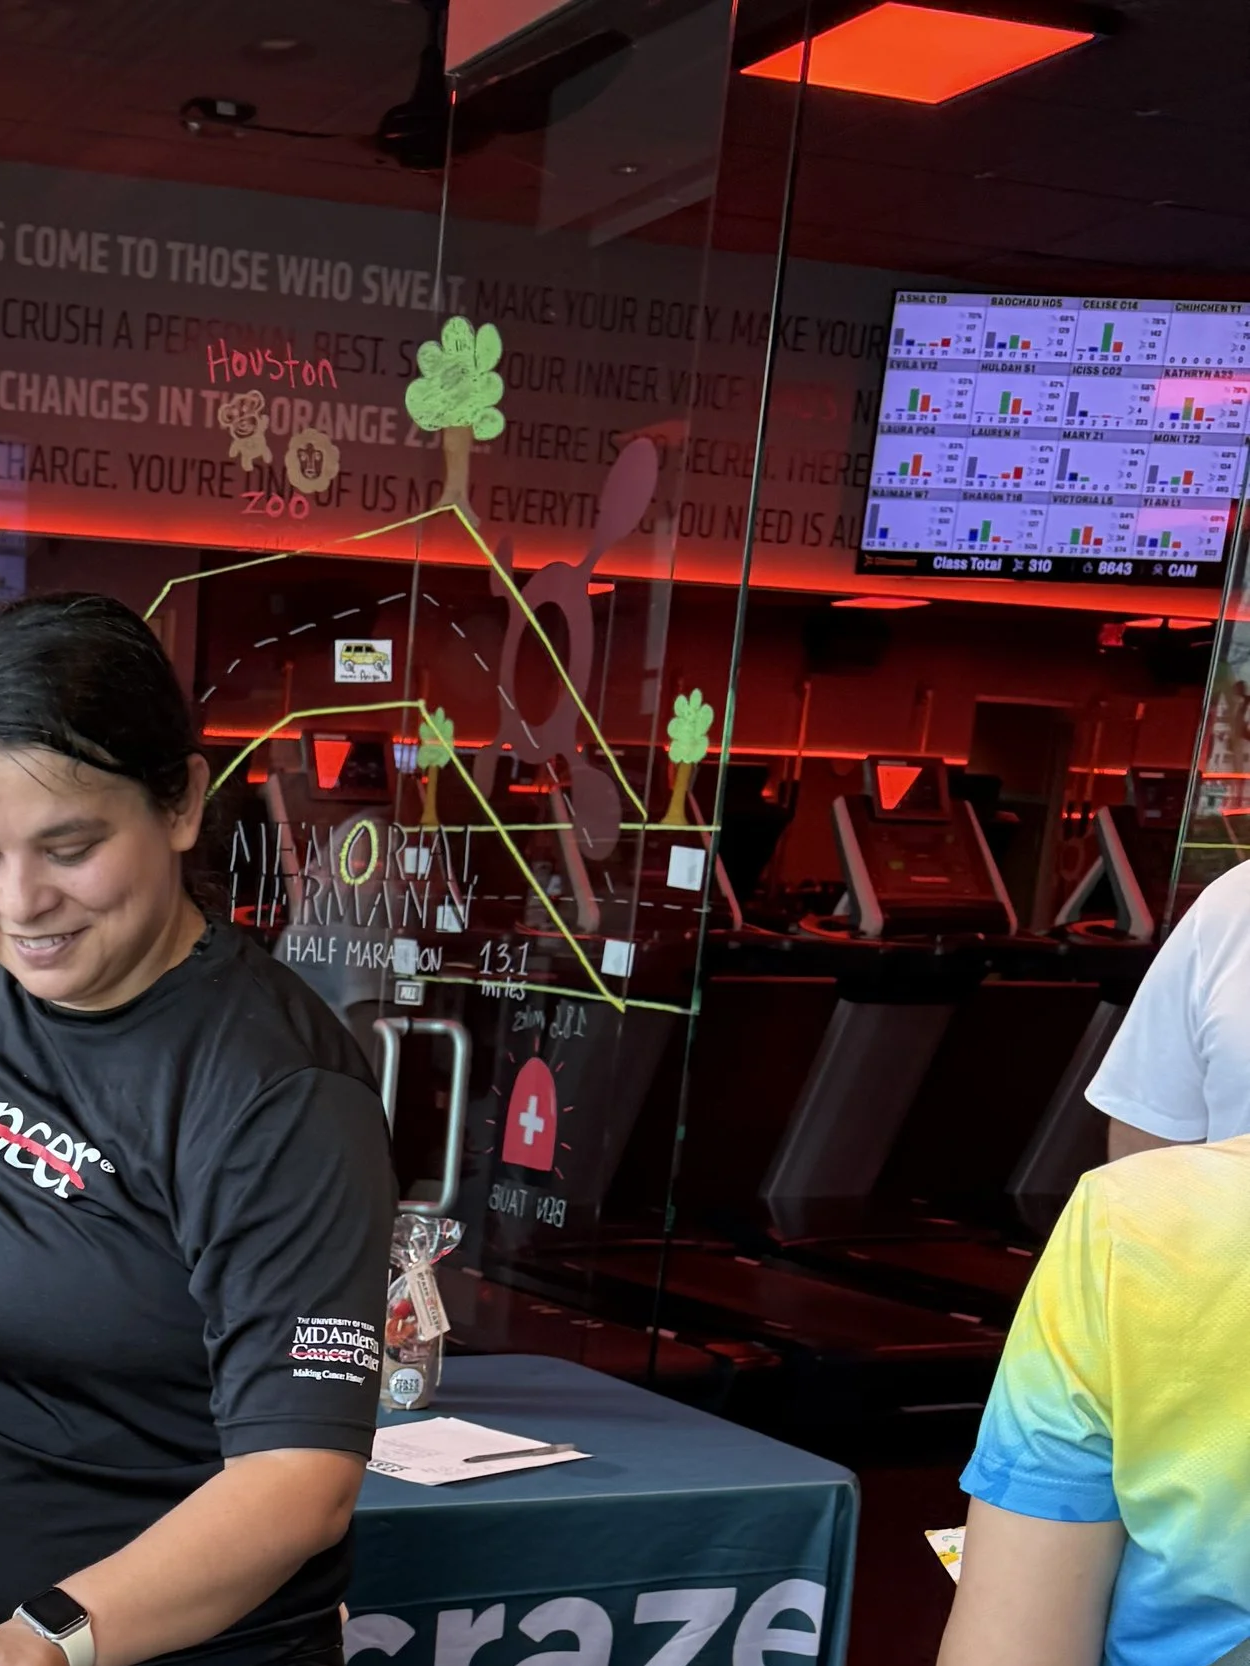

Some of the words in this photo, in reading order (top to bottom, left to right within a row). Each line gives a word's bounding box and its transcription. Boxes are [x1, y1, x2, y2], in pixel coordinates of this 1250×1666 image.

[13, 222, 111, 276] COME
[116, 234, 158, 281] TO
[165, 241, 268, 294] THOSE
[276, 254, 353, 303] WHO
[361, 266, 468, 313] SWEAT.
[474, 279, 555, 327] MAKE
[559, 290, 637, 335] YOUR
[728, 307, 811, 352] MAKE
[1082, 299, 1120, 310] CELISE
[1120, 300, 1139, 311] C14
[1, 297, 104, 348] CRUSH
[114, 309, 134, 350] A
[314, 331, 386, 376] BEST.
[575, 360, 658, 404] INNER
[206, 337, 338, 390] Houston
[980, 363, 1022, 373] HULDAH
[157, 383, 195, 429] IN
[269, 396, 399, 446] ORANGE
[504, 418, 592, 463] THERE
[880, 424, 913, 435] LAURA
[1062, 430, 1092, 441] MARY
[127, 450, 234, 501] YOU'RE
[361, 474, 402, 515] US
[801, 511, 824, 547] IS
[933, 556, 968, 570] Class
[970, 557, 1002, 572] Total
[1028, 559, 1053, 573] 310
[1168, 564, 1199, 577] CAM
[285, 934, 338, 965] HALF
[479, 940, 530, 977] 13.1
[288, 1343, 353, 1364] Cancer
[292, 1368, 321, 1380] Making
